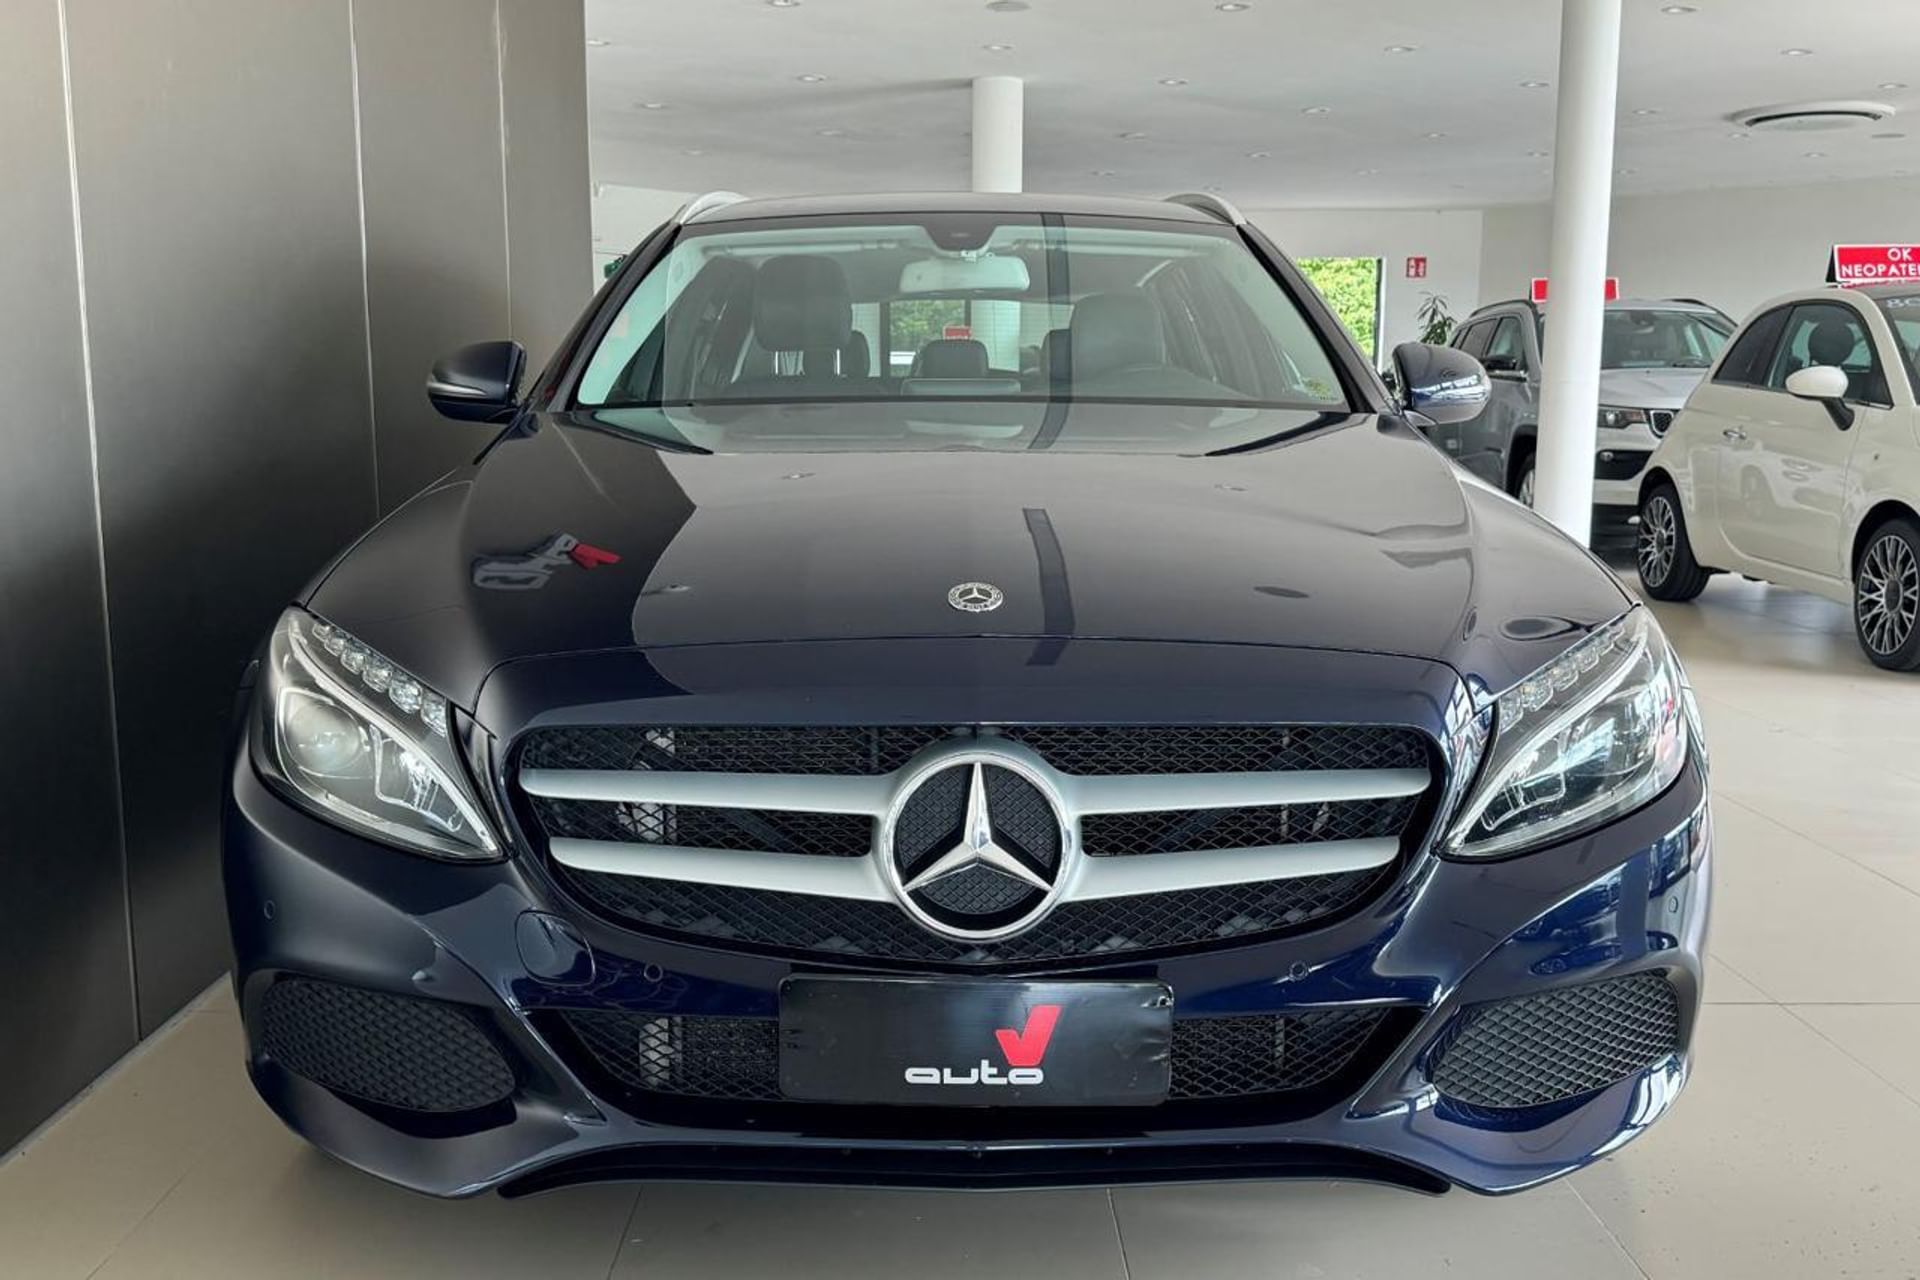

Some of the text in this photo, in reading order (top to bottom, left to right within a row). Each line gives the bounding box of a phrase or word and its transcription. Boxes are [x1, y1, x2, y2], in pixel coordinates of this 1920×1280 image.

[1887, 247, 1912, 262] OK
[1841, 263, 1920, 278] NEOPATE
[904, 1058, 1045, 1085] auto
